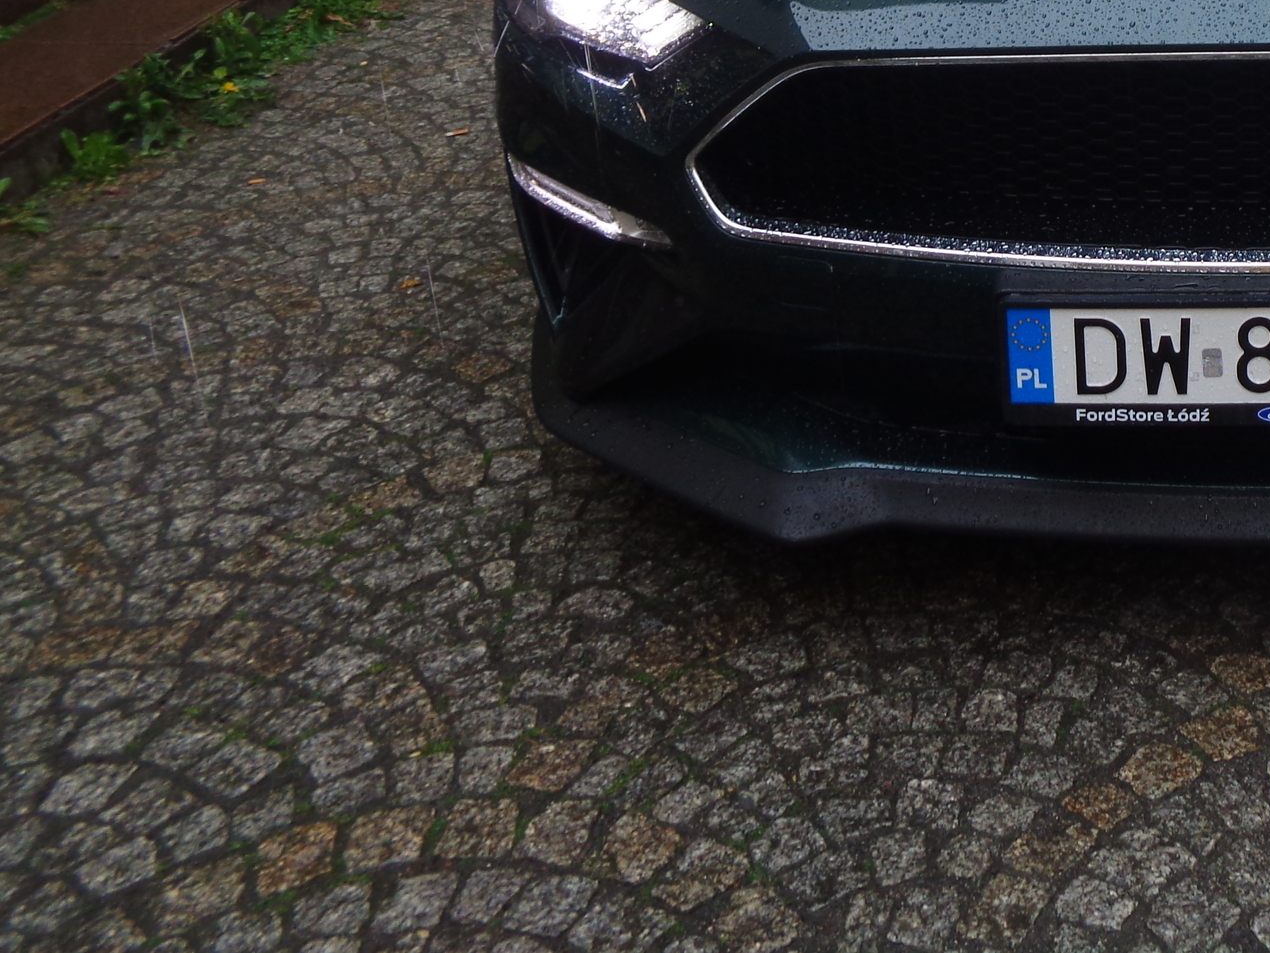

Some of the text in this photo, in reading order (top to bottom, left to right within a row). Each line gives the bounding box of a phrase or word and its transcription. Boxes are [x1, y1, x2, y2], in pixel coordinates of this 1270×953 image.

[1074, 317, 1191, 395] DW
[1016, 368, 1047, 388] PL
[1075, 407, 1210, 422] FordStore Łódź
